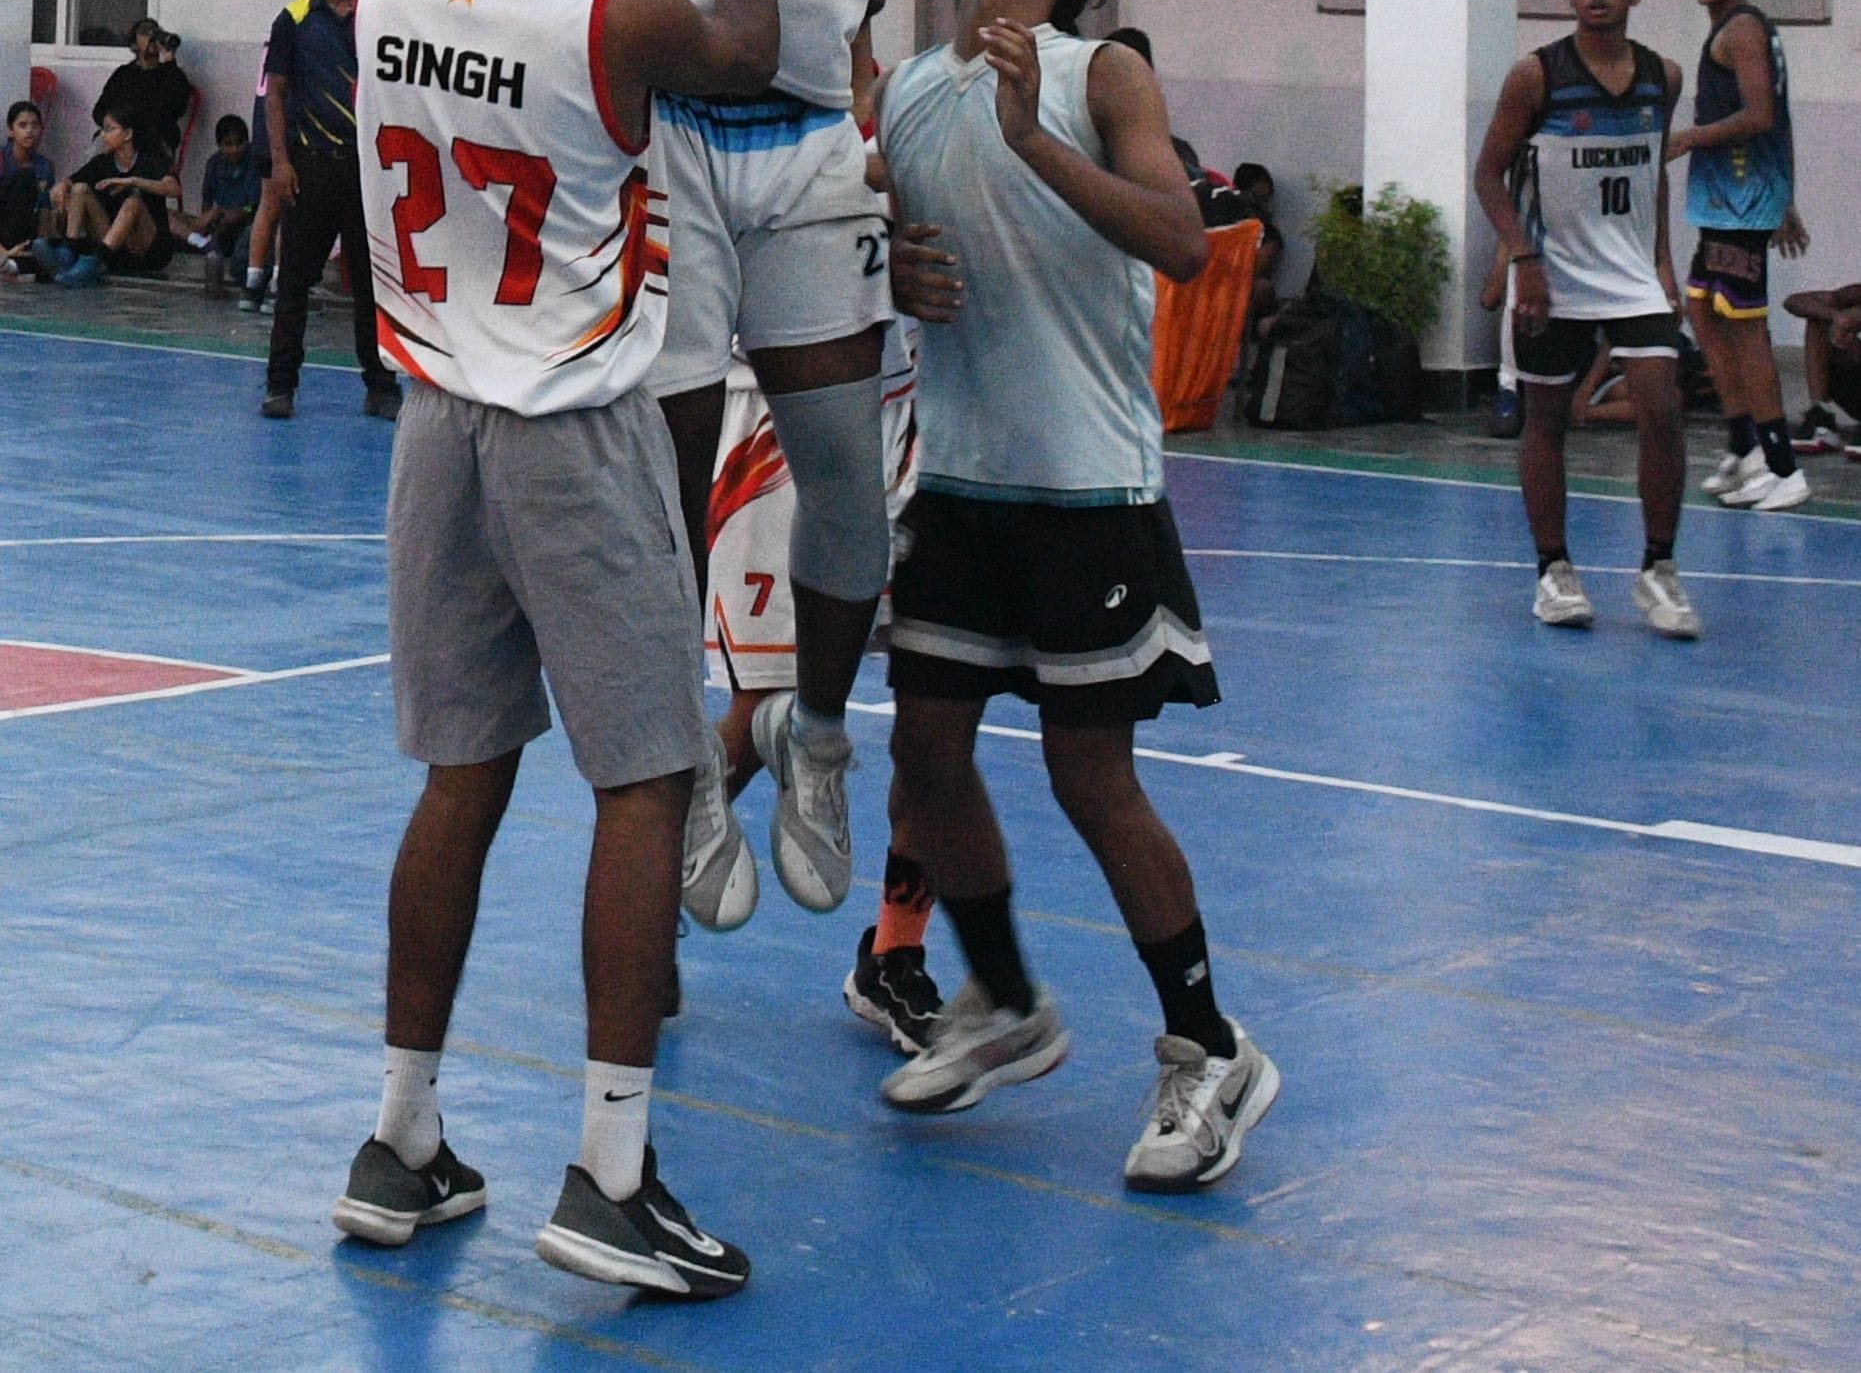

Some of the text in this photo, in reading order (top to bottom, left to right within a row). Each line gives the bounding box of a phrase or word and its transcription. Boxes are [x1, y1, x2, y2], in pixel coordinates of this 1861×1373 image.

[376, 34, 527, 110] SINGH
[1571, 144, 1651, 168] LUCKNOW
[375, 123, 558, 306] 27
[1599, 176, 1631, 215] 10
[744, 572, 775, 617] 7
